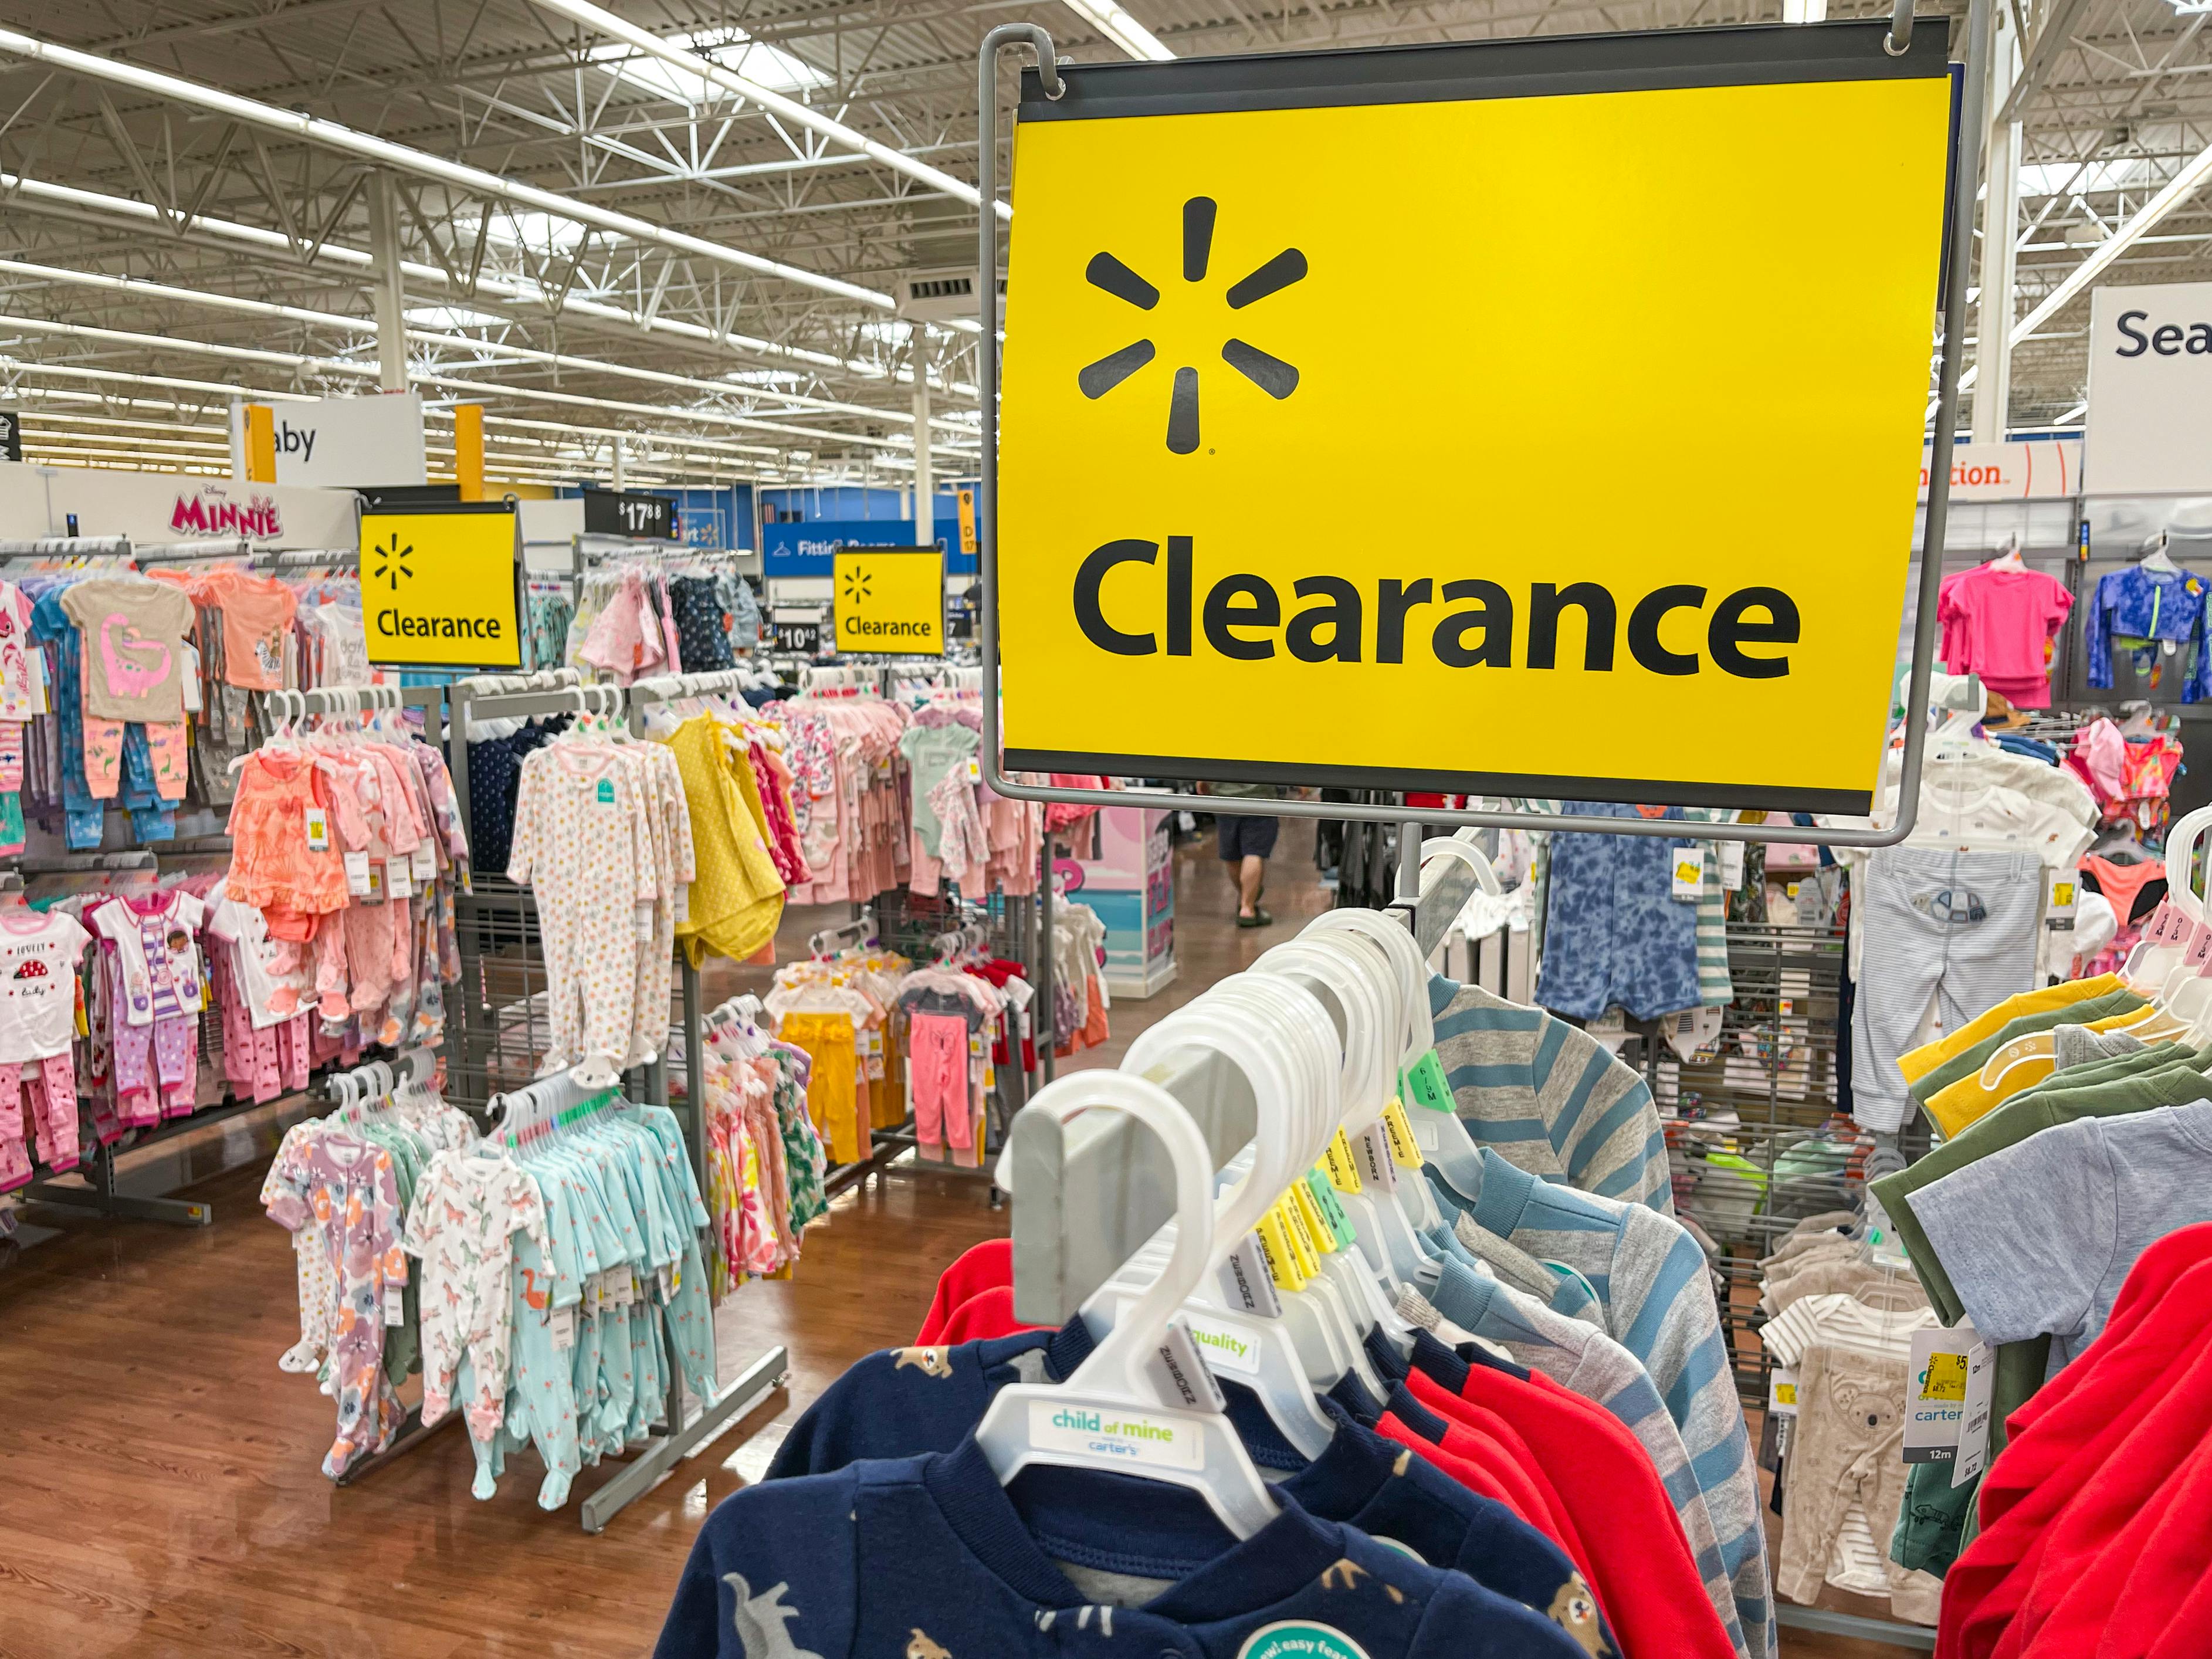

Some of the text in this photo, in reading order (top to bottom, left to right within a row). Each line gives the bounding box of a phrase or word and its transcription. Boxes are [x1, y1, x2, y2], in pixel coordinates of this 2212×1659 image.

[275, 419, 316, 463] aby
[171, 494, 280, 536] MINNIE
[964, 526, 973, 537] D
[377, 609, 501, 639] Clearance
[845, 616, 931, 636] Clearance
[1073, 535, 1801, 679] Clearance
[1380, 1125, 1397, 1183] NEWBORN
[1385, 1115, 1405, 1159] PREEMIE
[1326, 1147, 1343, 1186] REEMIE
[1339, 1130, 1359, 1189] PREEMIE
[1364, 1135, 1379, 1181] NEWBORN
[1255, 1227, 1281, 1282] PREEMIE
[1230, 1253, 1255, 1309] NEWBORN
[1192, 1329, 1248, 1357] quality
[1160, 1345, 1197, 1406] NEWBORN
[1923, 1365, 1935, 1394] Clearance
[1052, 1409, 1173, 1443] child of mine
[1915, 1410, 1963, 1421] carter
[1089, 1440, 1138, 1456] carter's
[1929, 1450, 1952, 1460] 12m
[1260, 1641, 1282, 1659] ew!
[1282, 1639, 1315, 1654] easy
